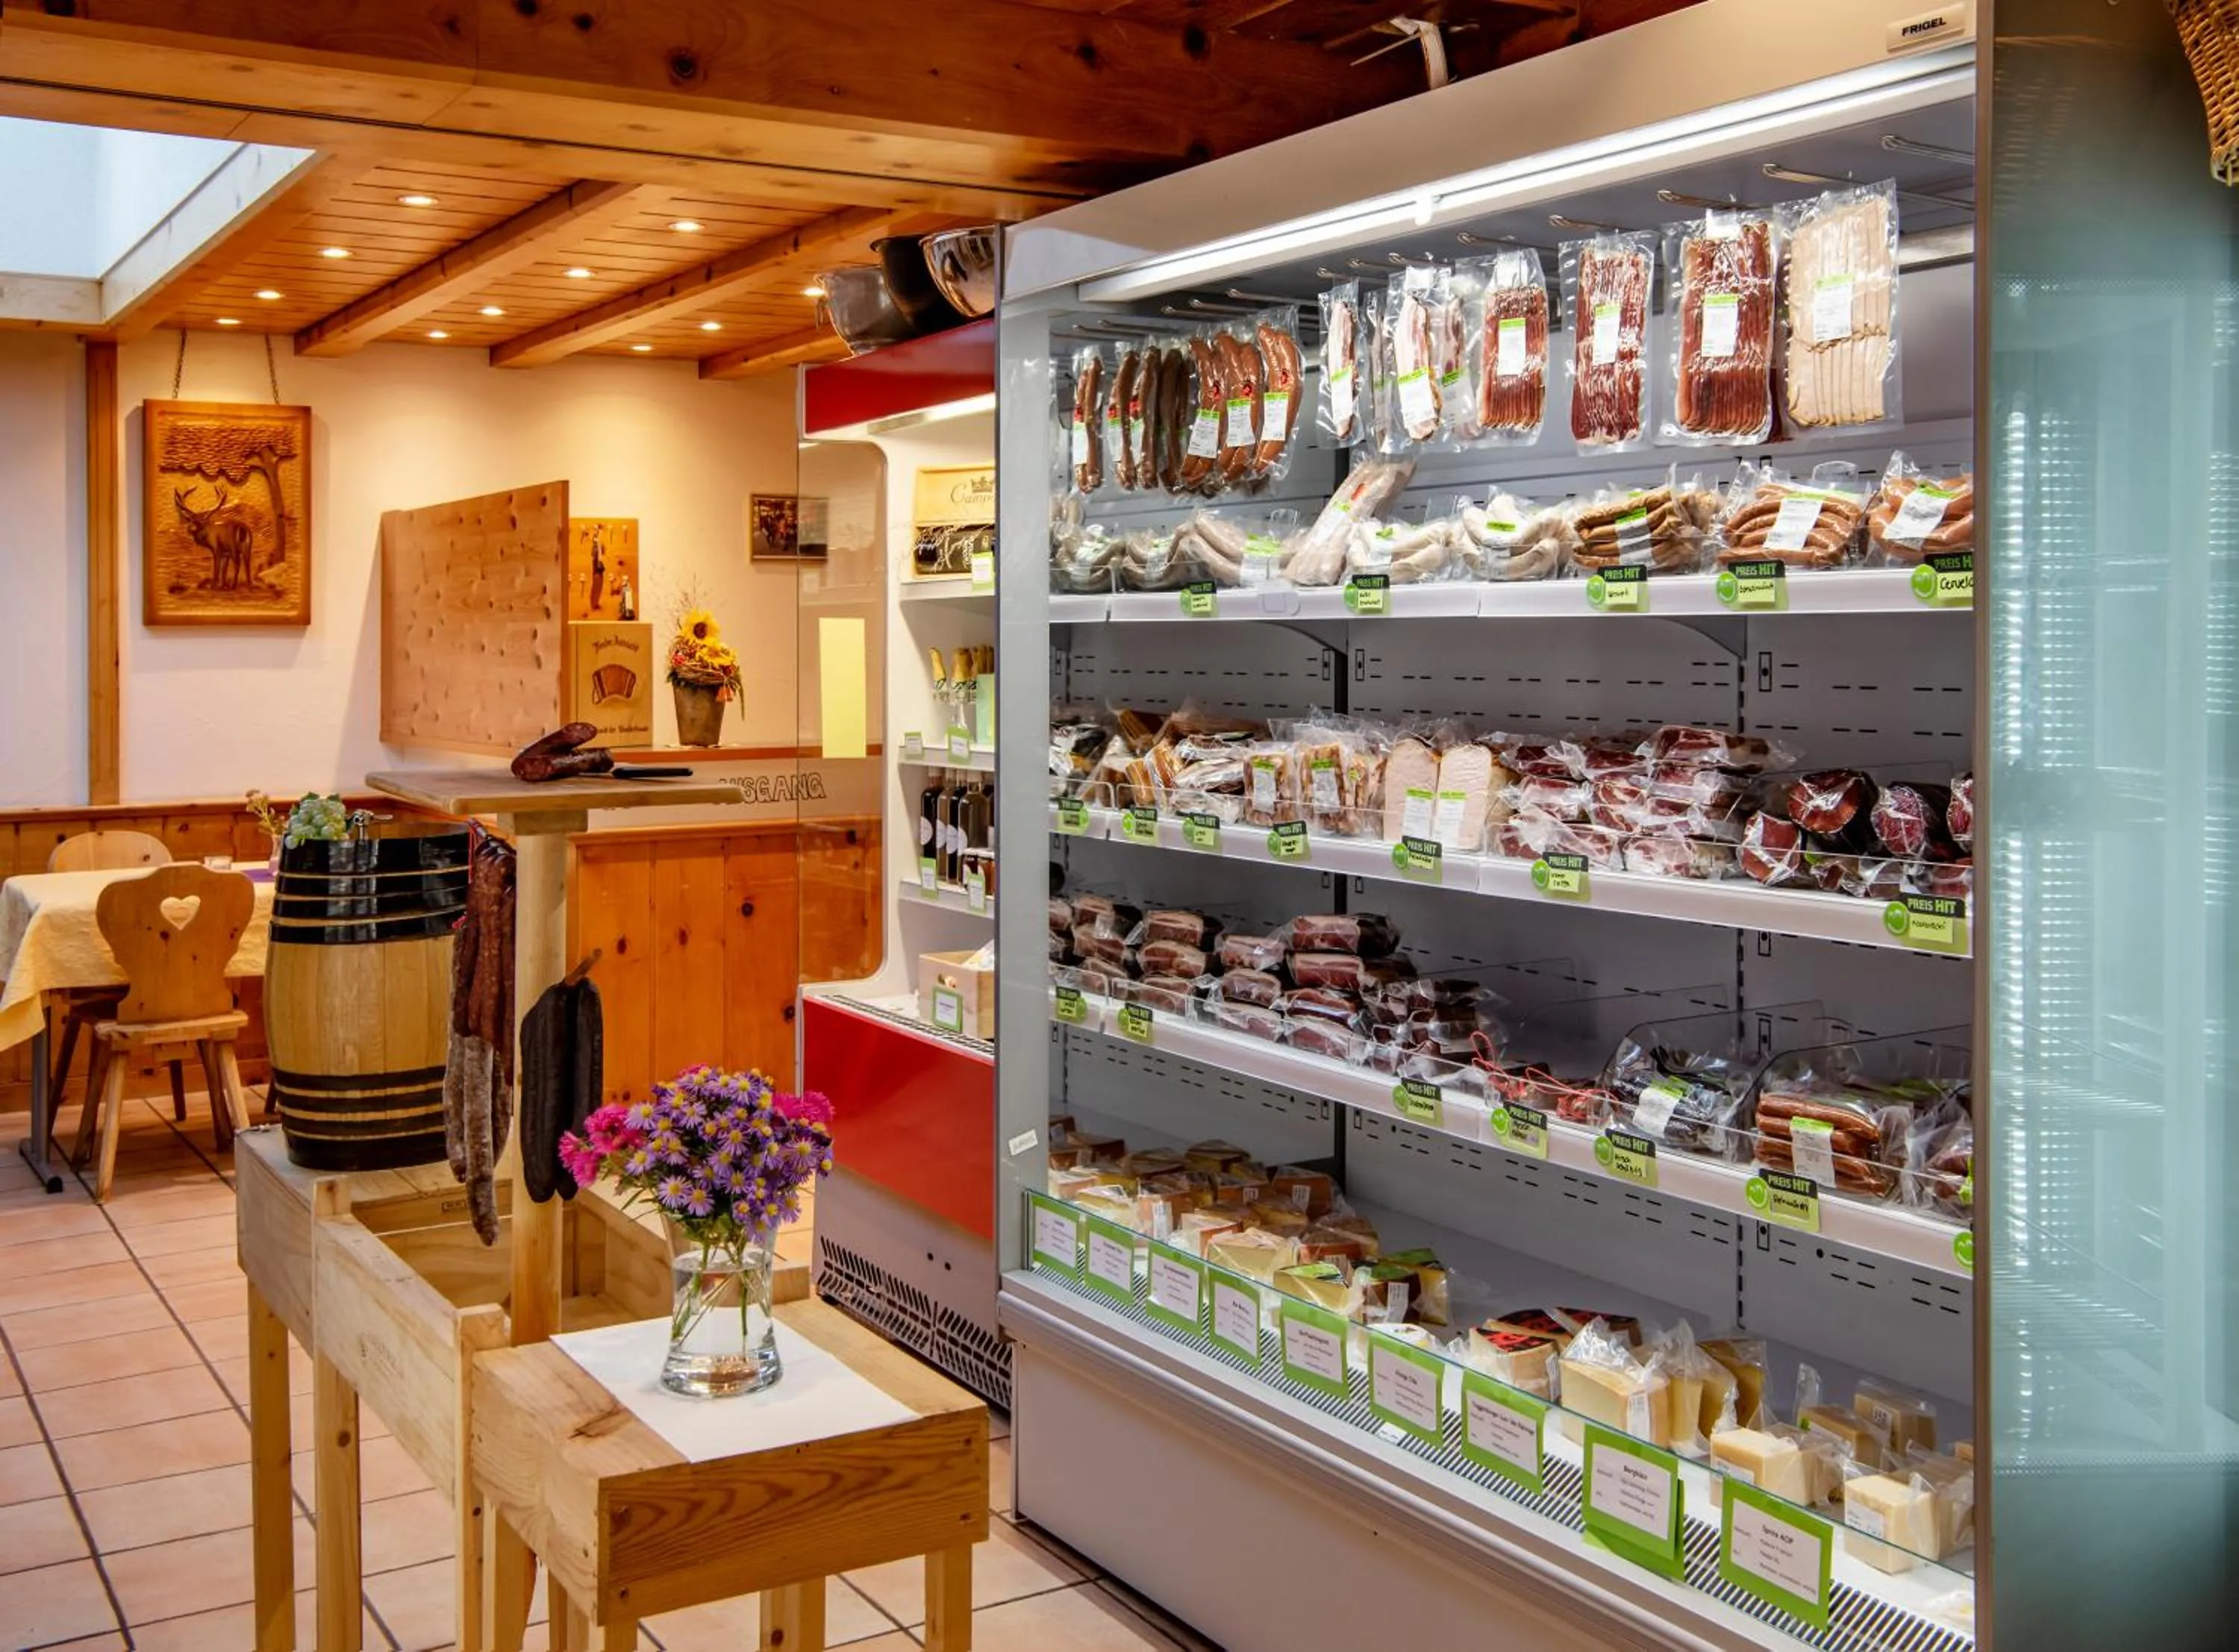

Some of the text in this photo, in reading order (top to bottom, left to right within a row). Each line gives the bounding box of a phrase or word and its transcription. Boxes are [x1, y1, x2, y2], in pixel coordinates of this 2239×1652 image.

[1902, 17, 1946, 36] FRIGEL
[1758, 563, 1776, 575] HIT
[1934, 557, 1961, 569] PREIS
[1624, 568, 1640, 579] HIT
[719, 772, 826, 804] SGANG
[1908, 898, 1956, 914] PREIS HIT
[1632, 1137, 1649, 1153] HIT
[1793, 1178, 1811, 1194] HIT
